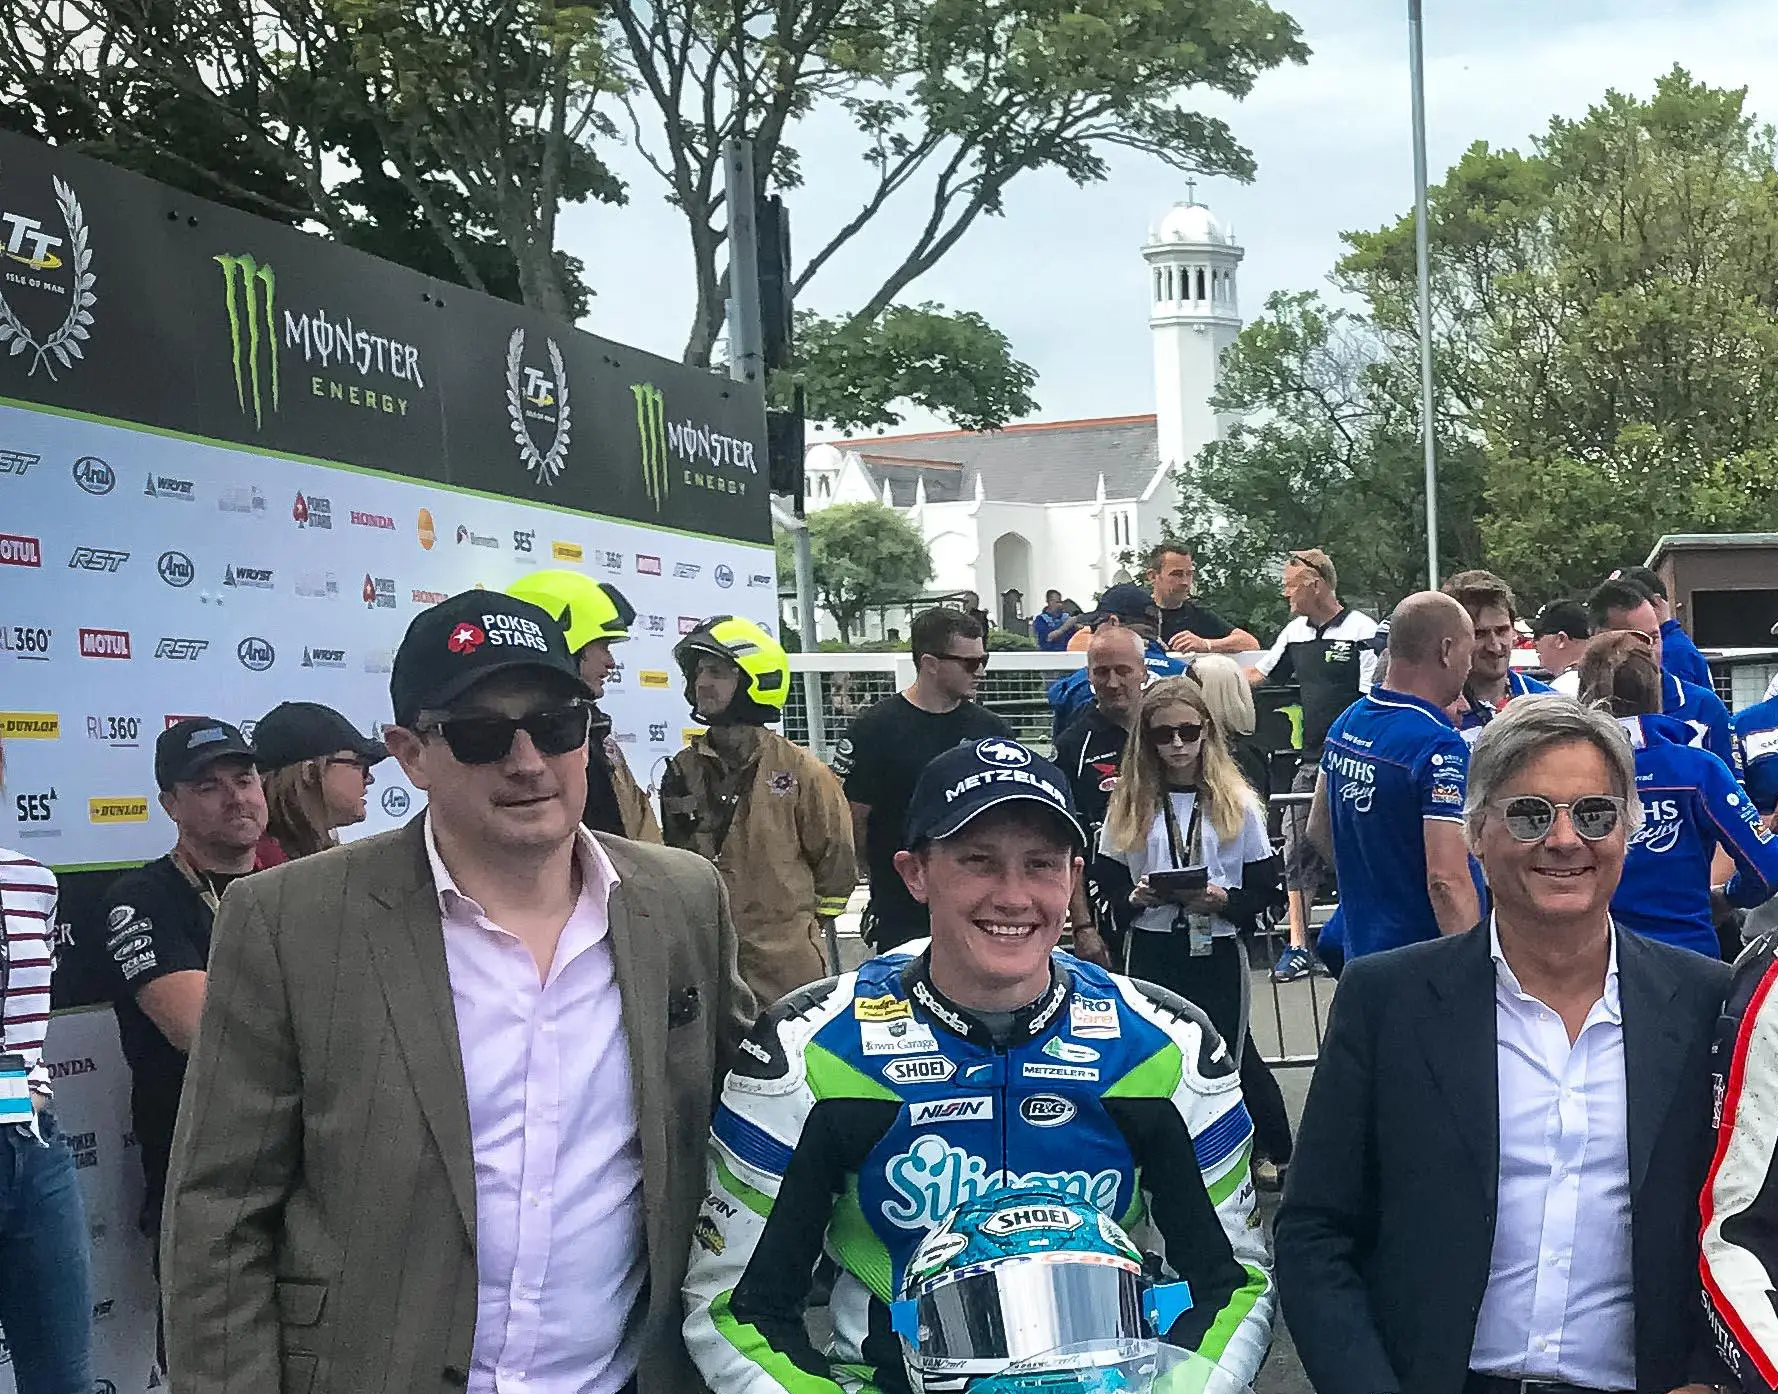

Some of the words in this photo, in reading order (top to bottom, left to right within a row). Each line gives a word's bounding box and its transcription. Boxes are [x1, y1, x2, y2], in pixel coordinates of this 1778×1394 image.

[2, 211, 63, 268] TT
[284, 309, 424, 390] MONSTER
[312, 376, 408, 416] ENERGY
[668, 418, 758, 475] MONSTER
[0, 452, 40, 475] ST
[683, 470, 746, 496] ENERGY
[350, 511, 396, 530] HONDA
[0, 540, 38, 563] OTUL
[69, 547, 130, 572] RST
[481, 614, 544, 637] POKER
[83, 633, 129, 656] MOTUL
[154, 638, 209, 660] RST
[488, 630, 549, 652] STARS
[7, 719, 58, 733] DUNLOP
[946, 770, 1066, 808] METZELER
[17, 794, 50, 822] SES
[101, 804, 147, 817] DUNLOP
[1071, 993, 1111, 1012] PRO
[49, 1058, 97, 1080] ONDA
[894, 1061, 945, 1078] SHOEI
[1024, 1066, 1086, 1077] METZELER
[1029, 1101, 1067, 1116] R&G
[999, 1208, 1070, 1230] SHOEI
